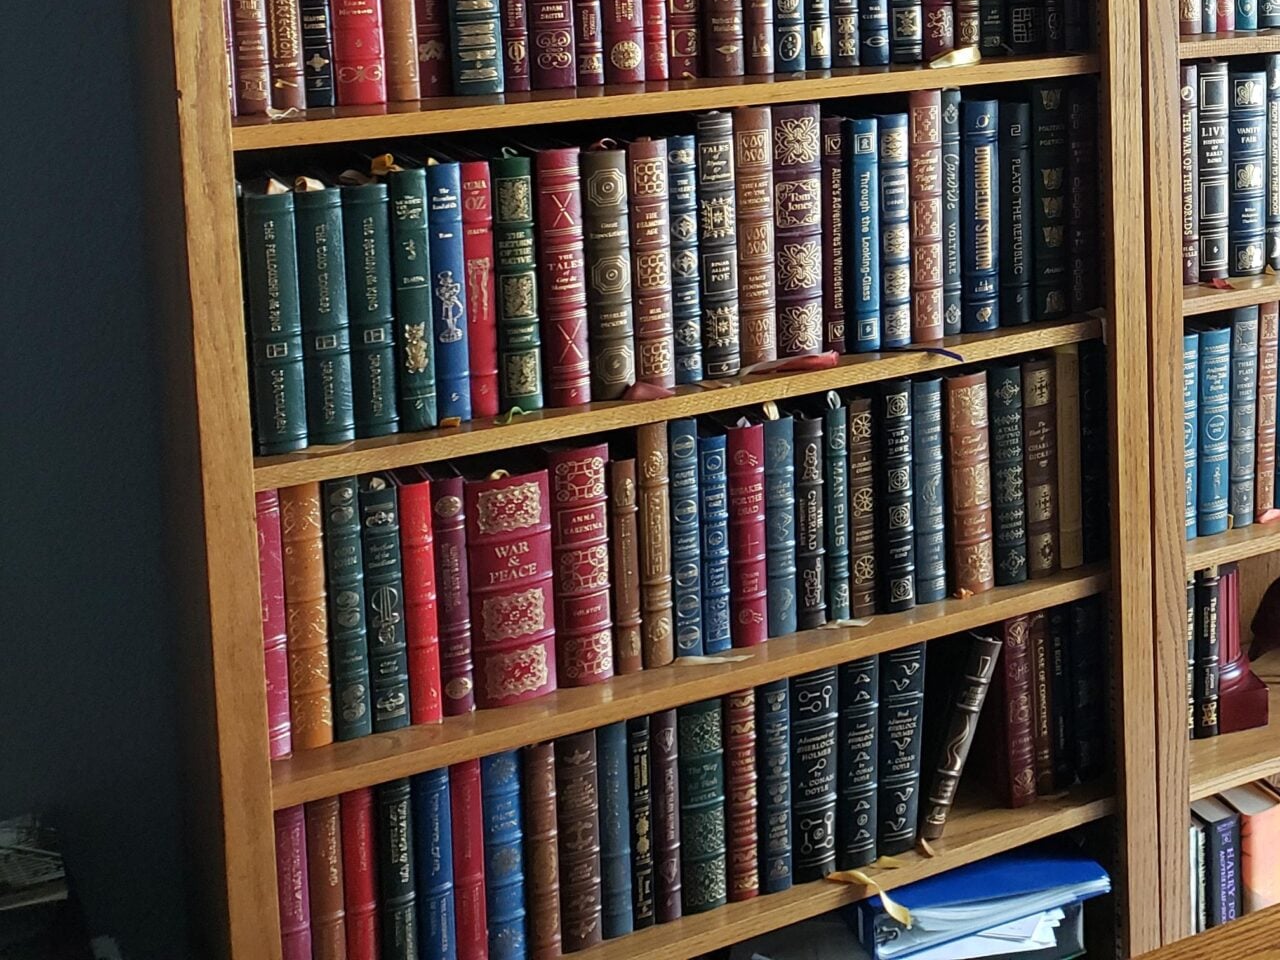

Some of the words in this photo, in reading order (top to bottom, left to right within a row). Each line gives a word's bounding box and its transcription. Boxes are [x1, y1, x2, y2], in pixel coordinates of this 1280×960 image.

[1182, 113, 1191, 131] THE
[1201, 126, 1226, 137] LIVY
[702, 144, 729, 154] TALES
[1182, 133, 1192, 157] WAR
[1182, 159, 1192, 172] OF
[831, 168, 841, 197] Alice's
[944, 153, 960, 210] Candide
[974, 147, 991, 219] DOWNBELOW
[1012, 158, 1021, 194] PLATO
[1183, 174, 1192, 191] THE
[790, 192, 810, 202] Tom
[860, 171, 870, 213] Through
[465, 197, 486, 211] OZ
[788, 202, 813, 212] Jones
[1014, 198, 1023, 215] THE
[834, 197, 843, 247] Adventures
[1183, 192, 1193, 235] WORLDS
[835, 248, 842, 258] in
[949, 222, 958, 275] VOLTAIRE
[975, 223, 991, 270] STATION
[1014, 218, 1024, 275] REPUBLIC
[548, 259, 583, 271] TALES
[863, 236, 873, 302] Looking-Glass
[711, 272, 730, 282] POE
[834, 259, 844, 309] Wonderland
[833, 461, 843, 498] MAN
[572, 513, 596, 522] ANNA
[807, 490, 817, 551] CYBERIAD
[833, 504, 845, 548] PLUS
[564, 521, 604, 535] KARENINA
[495, 541, 529, 559] WAR
[507, 556, 520, 567] &
[490, 562, 537, 584] PEACE
[1039, 671, 1045, 681] OF
[1039, 684, 1048, 736] CONSCIENCE
[797, 739, 835, 753] SHERLOCK
[802, 747, 831, 760] HOLMES
[805, 784, 829, 796] DOYLE
[1227, 848, 1235, 896] HARRY
